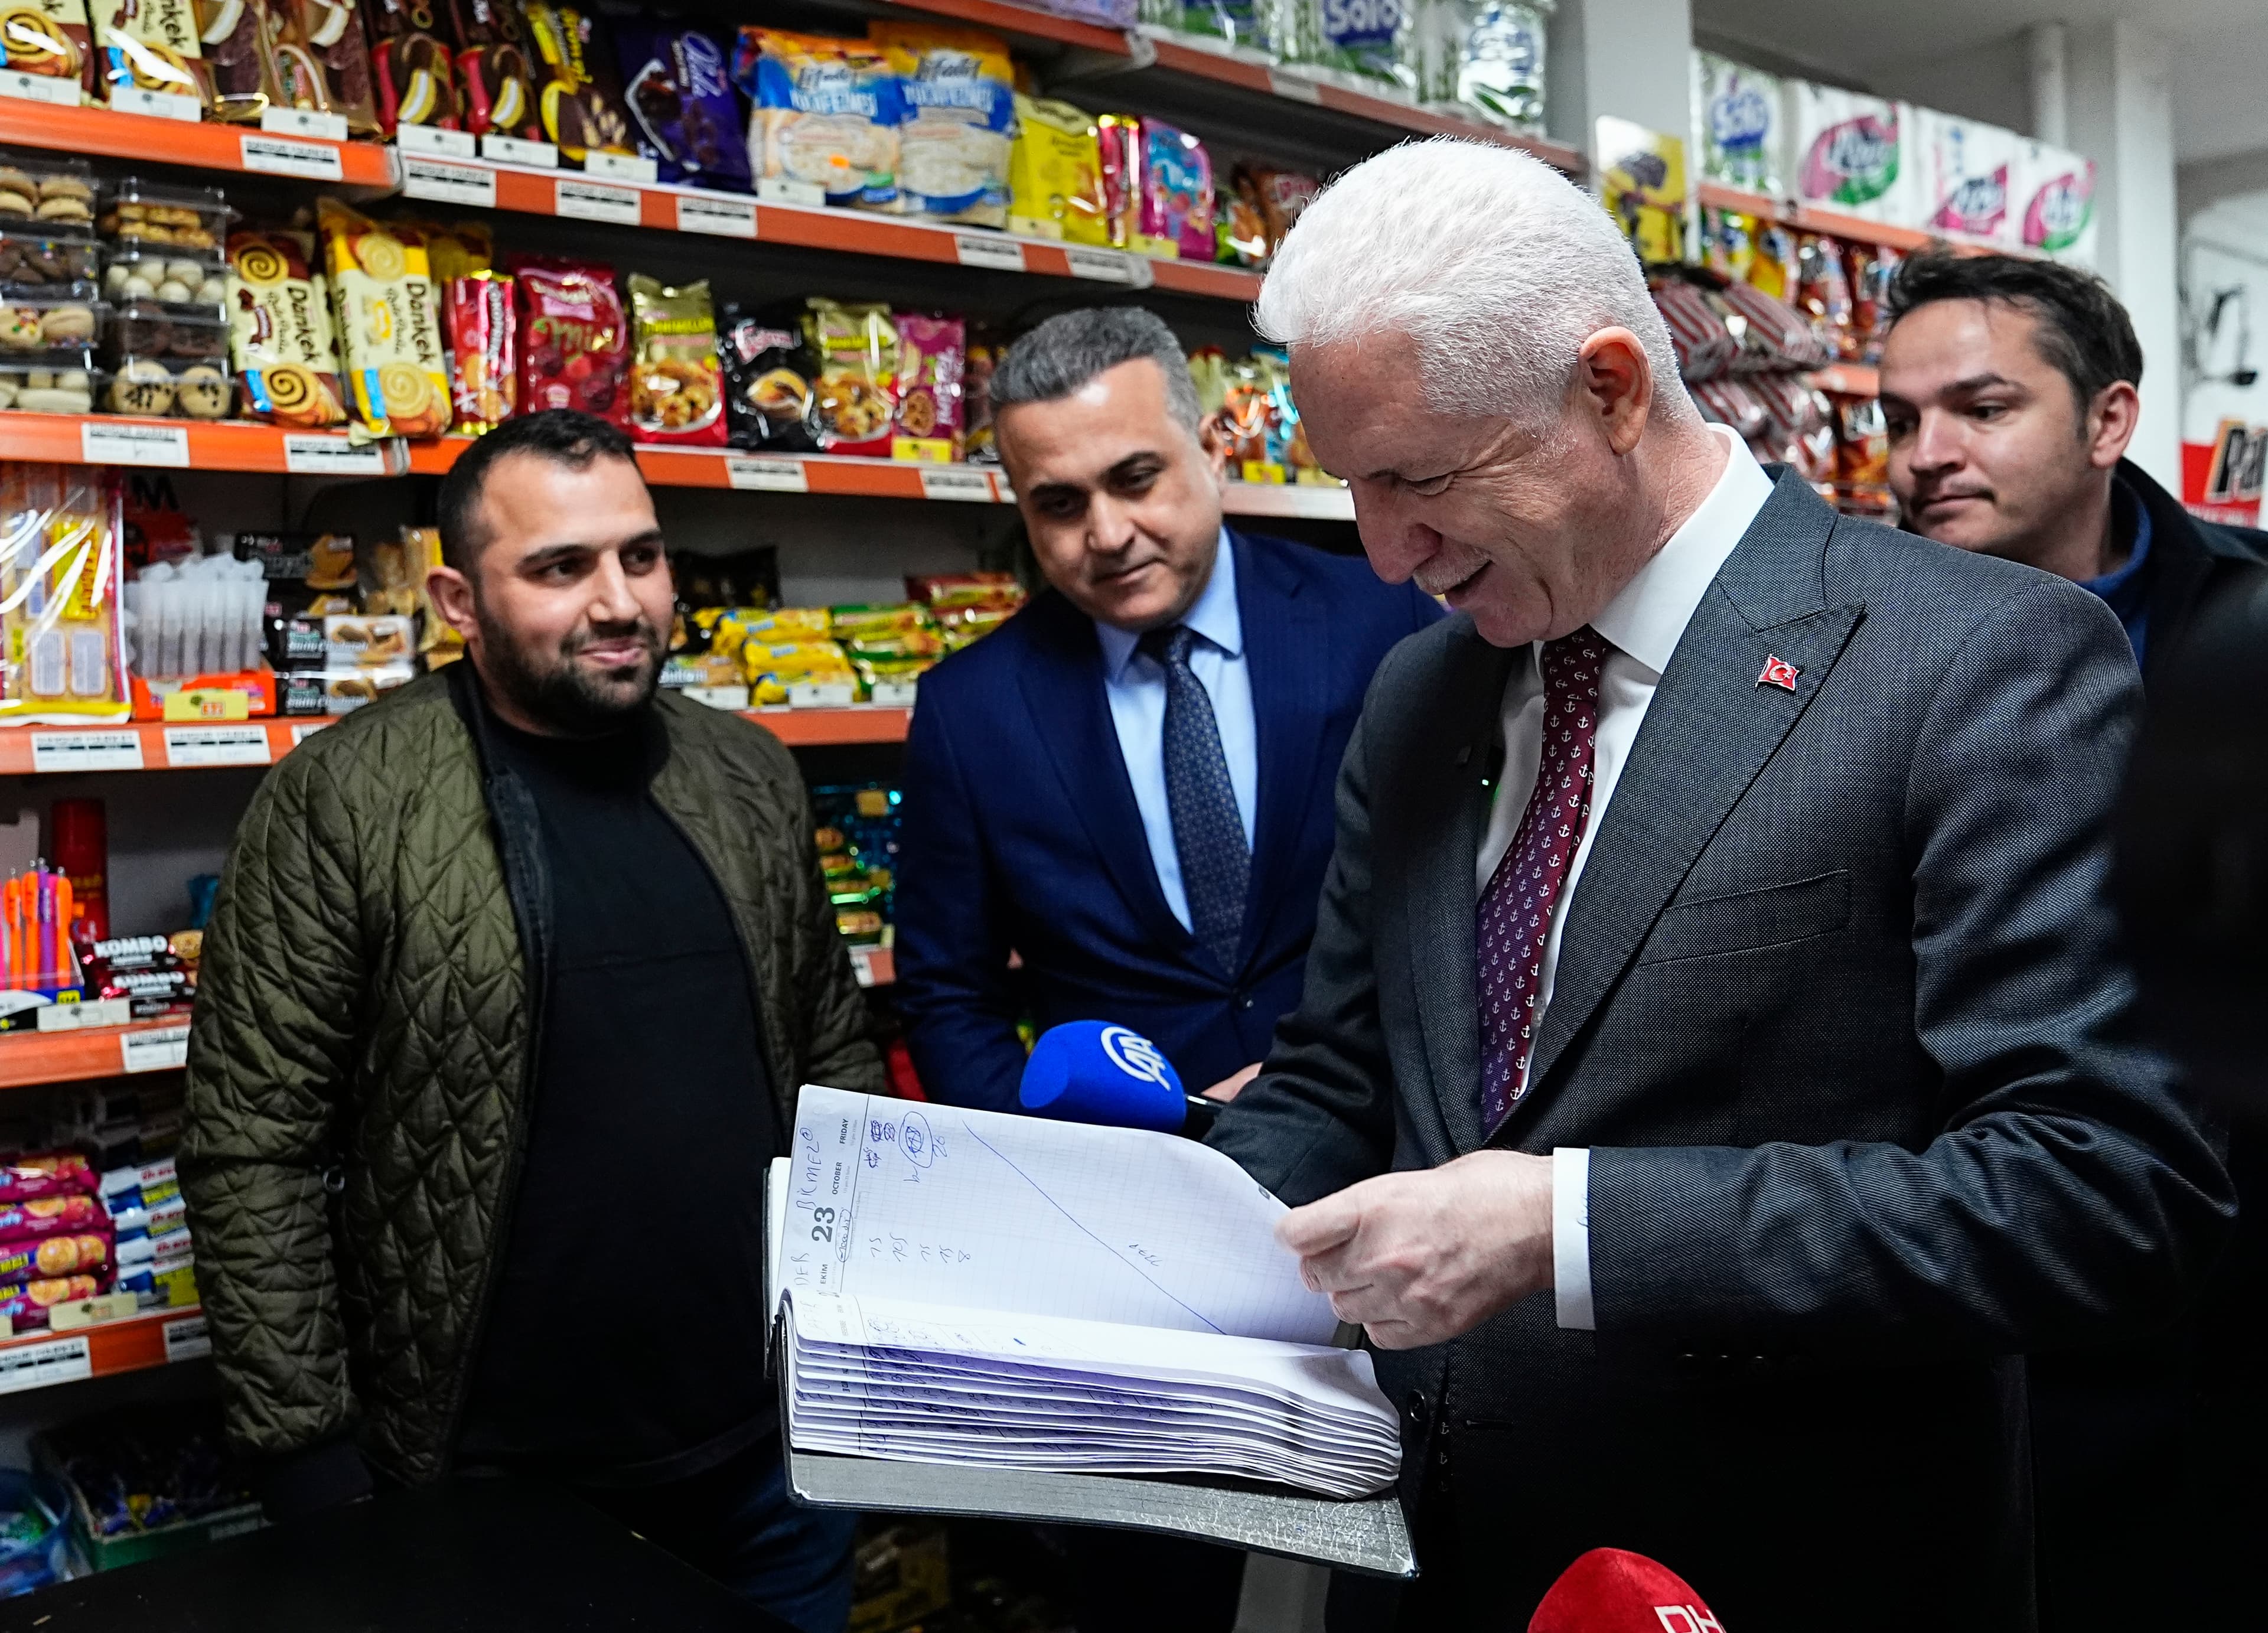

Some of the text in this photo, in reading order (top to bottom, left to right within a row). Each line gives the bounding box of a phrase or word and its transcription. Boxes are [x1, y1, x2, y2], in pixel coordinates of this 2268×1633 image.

[406, 283, 436, 363] Dankek
[839, 1119, 849, 1145] FRIDAY
[832, 1162, 843, 1195] OCTOBER
[812, 1207, 835, 1243] 23
[820, 1264, 829, 1285] EKİM
